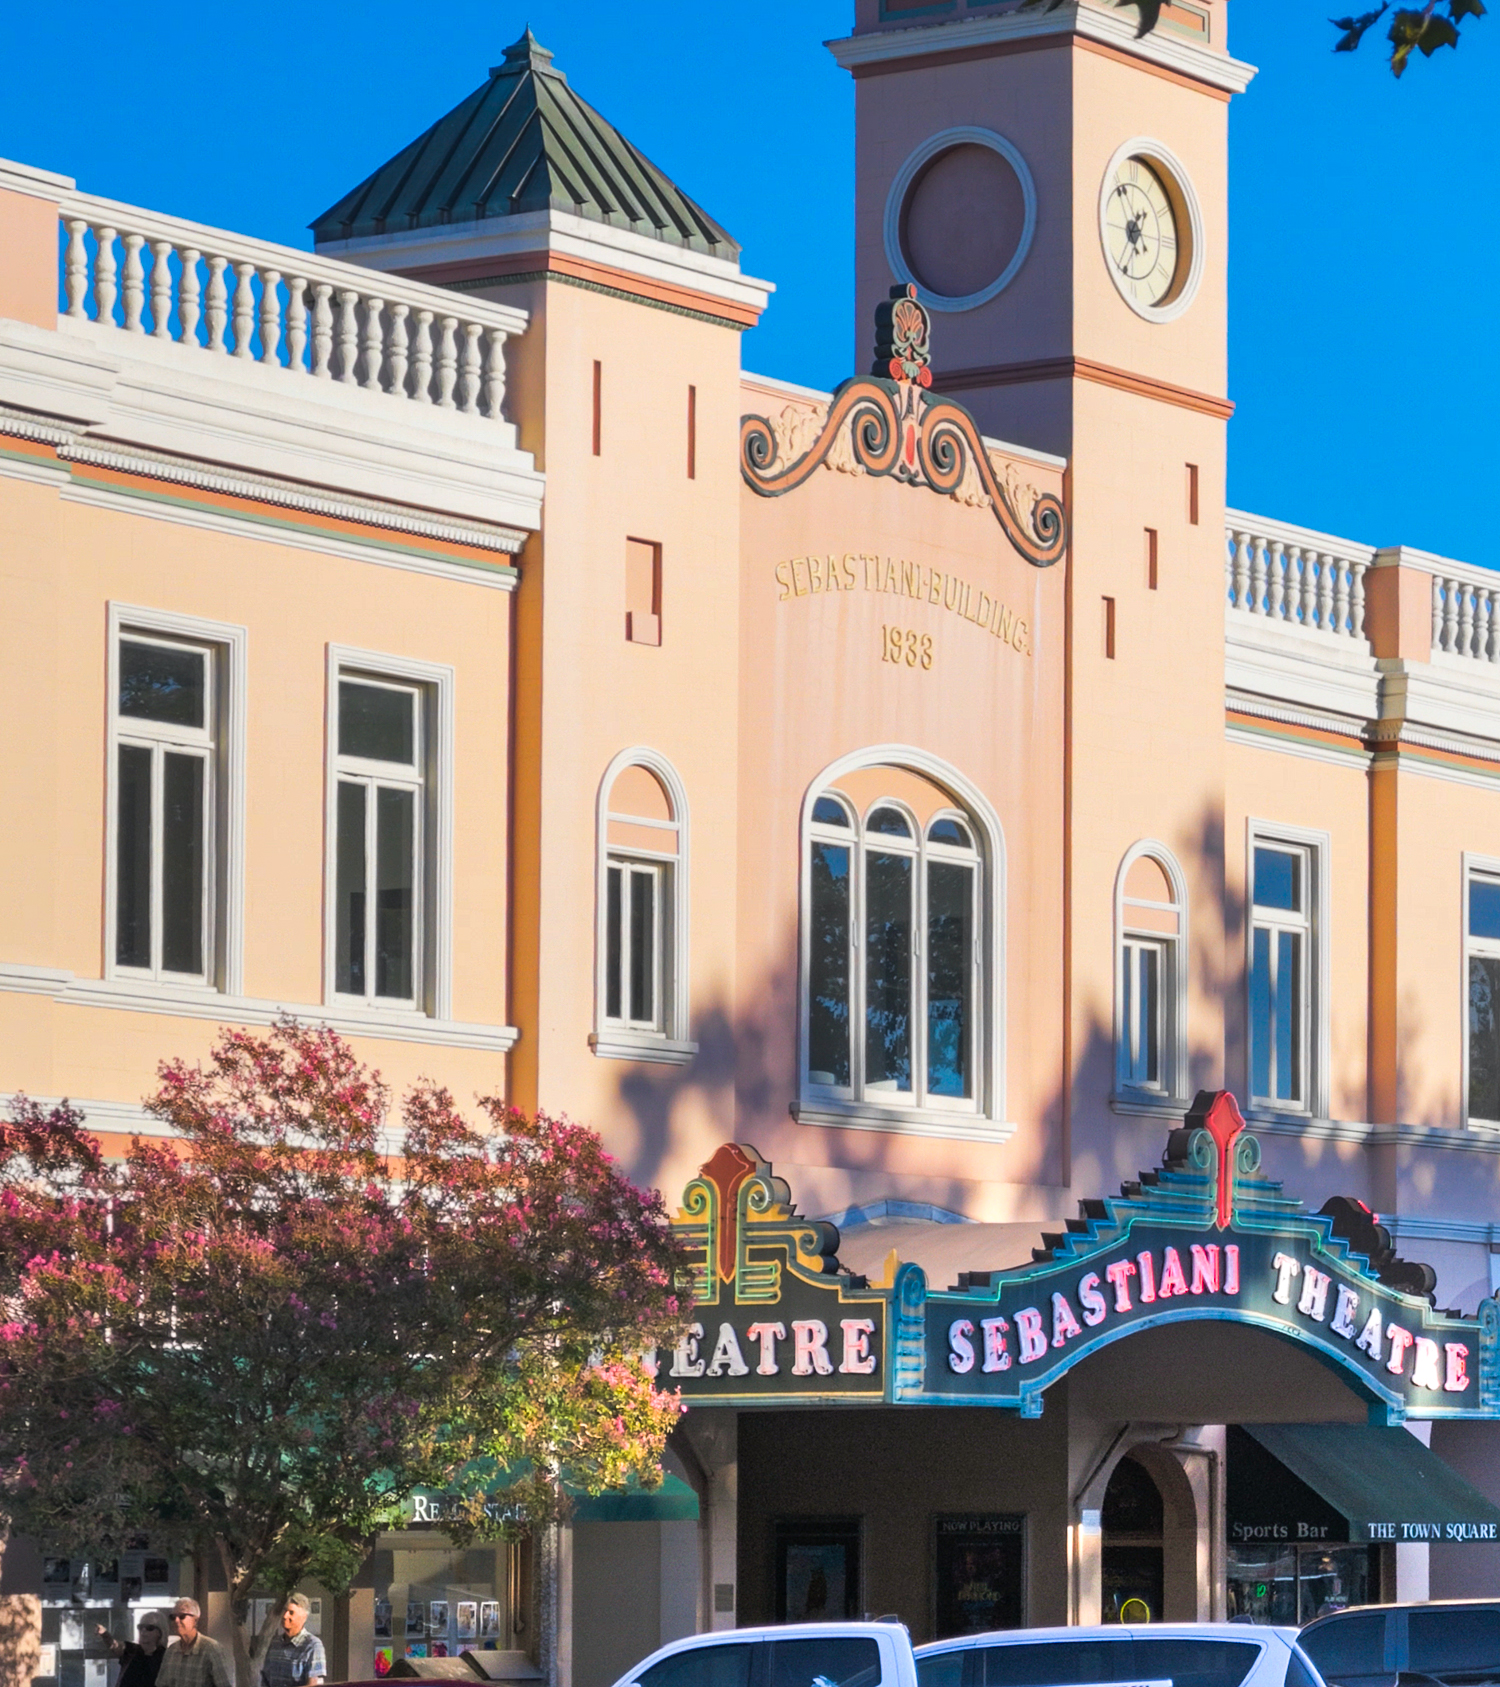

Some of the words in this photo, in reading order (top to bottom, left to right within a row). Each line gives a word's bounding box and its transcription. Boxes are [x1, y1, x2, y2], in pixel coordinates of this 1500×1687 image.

[881, 623, 933, 671] 1933
[947, 1243, 1241, 1374] SEBASTIANI
[1272, 1251, 1471, 1392] THEATRE
[942, 1520, 968, 1532] NOW
[969, 1520, 1020, 1532] PLAYING
[1232, 1521, 1288, 1541] Sports
[1296, 1521, 1329, 1539] Bar
[1367, 1522, 1397, 1539] THE
[1400, 1522, 1442, 1539] TOWN
[1445, 1522, 1498, 1542] SQUARE
